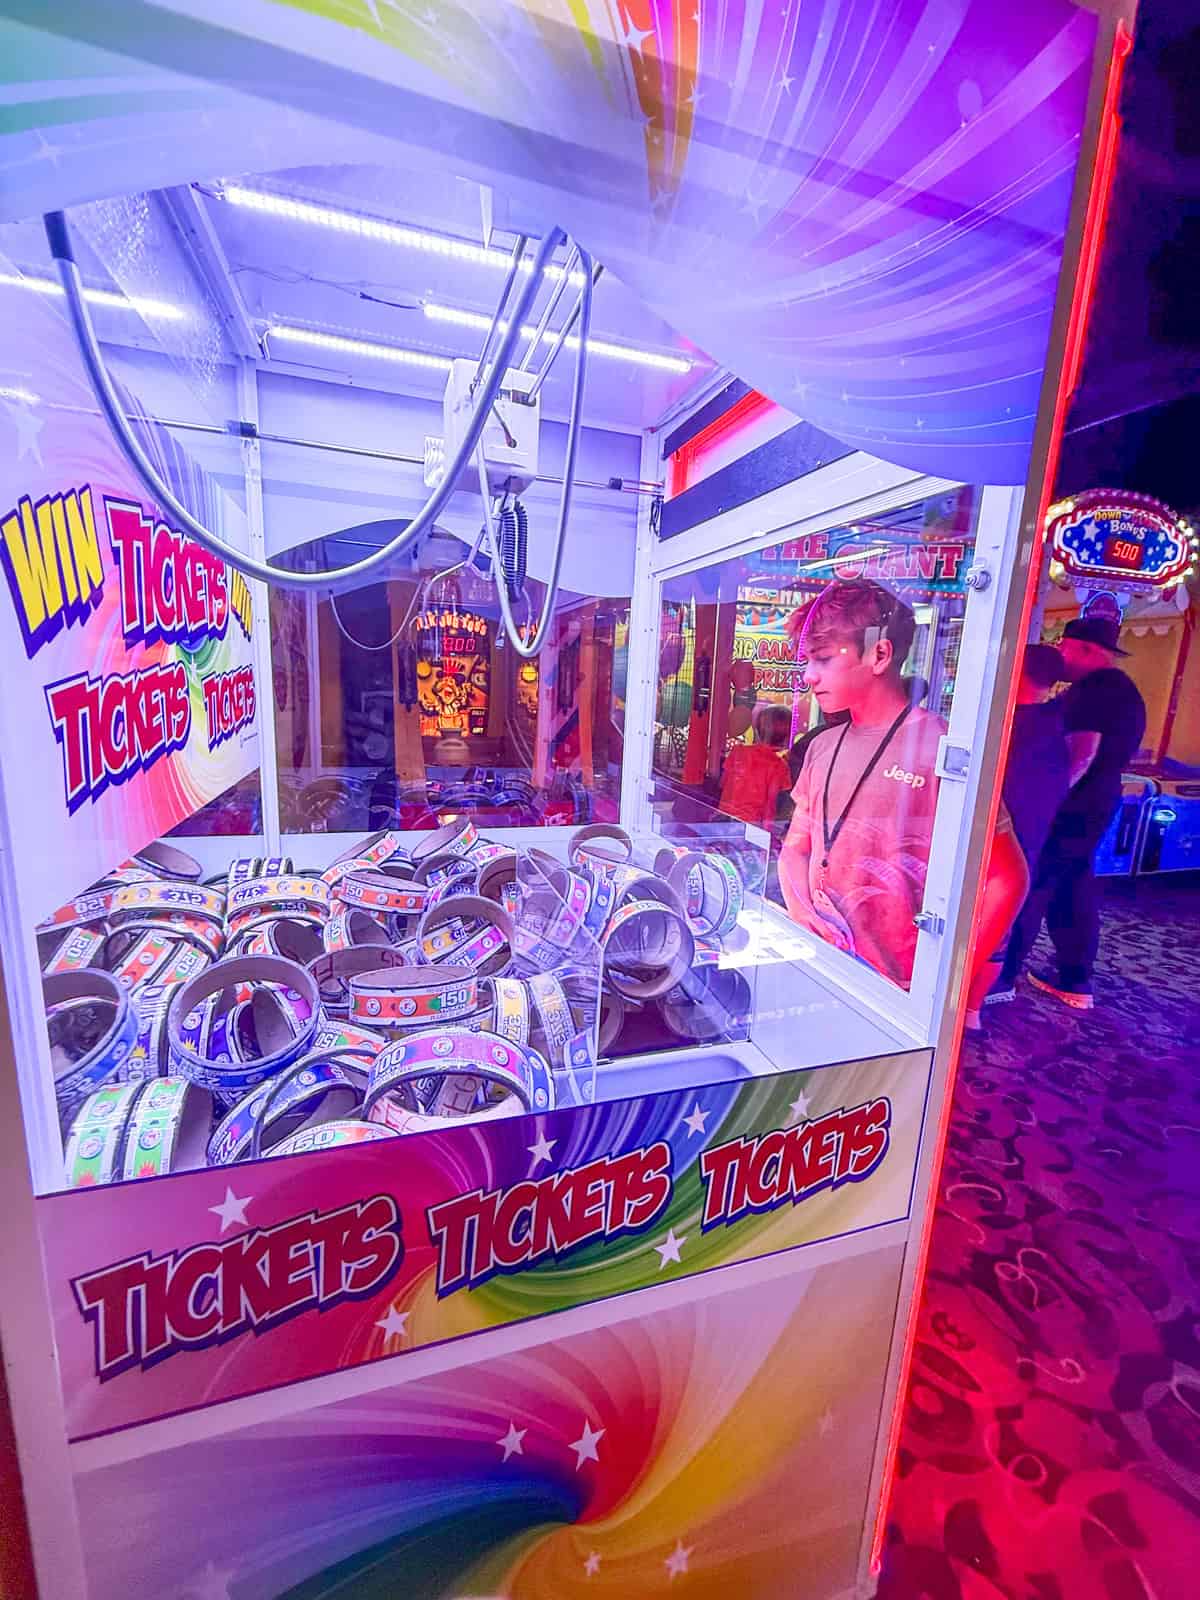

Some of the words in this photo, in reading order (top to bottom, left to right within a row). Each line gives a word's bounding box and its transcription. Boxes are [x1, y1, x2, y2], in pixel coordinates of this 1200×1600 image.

[832, 544, 964, 580] GIANT
[1112, 541, 1139, 561] 500
[0, 485, 104, 655] WIN
[103, 495, 229, 646] TICKETS
[45, 661, 191, 814] TICKETS
[201, 664, 255, 750] TICKETS
[883, 764, 925, 789] Jeep
[438, 988, 468, 1010] 150
[315, 1031, 338, 1048] 150
[374, 1045, 406, 1077] 100
[71, 1196, 403, 1381] TICKETS
[428, 1141, 674, 1299] TICKETS
[701, 1097, 892, 1233] TICKETS
